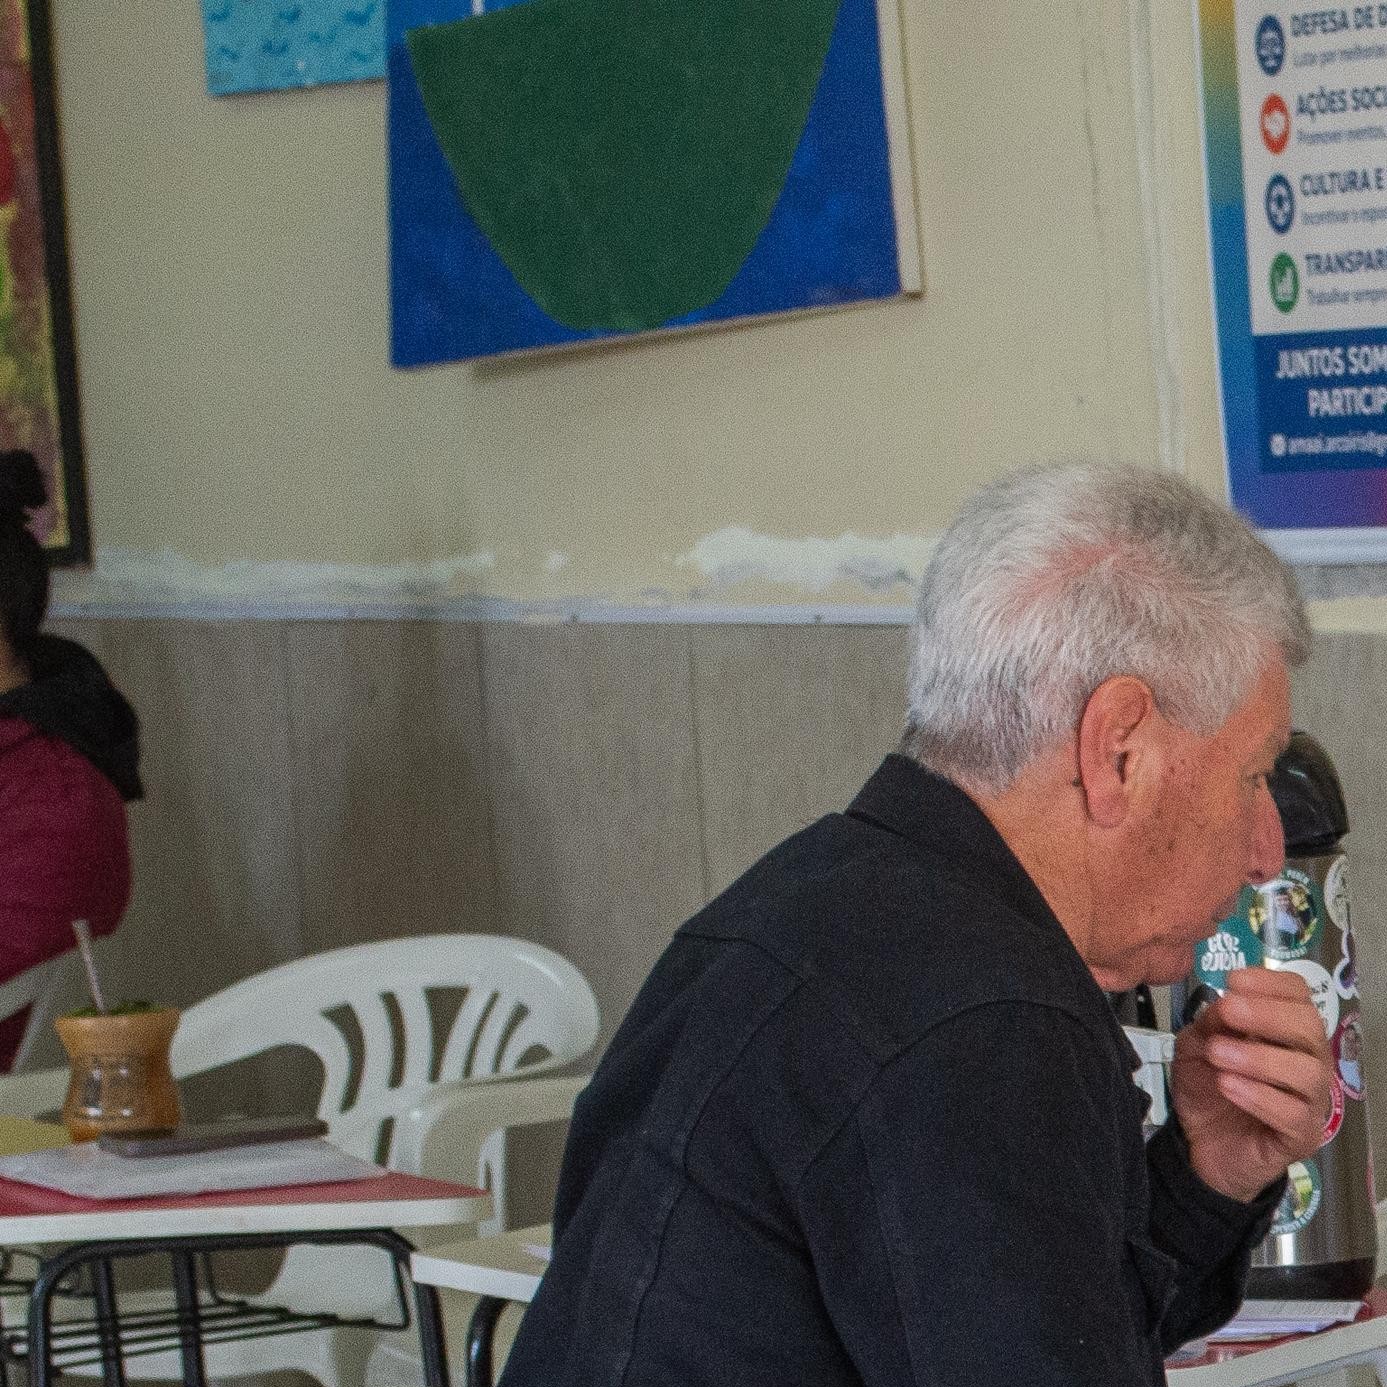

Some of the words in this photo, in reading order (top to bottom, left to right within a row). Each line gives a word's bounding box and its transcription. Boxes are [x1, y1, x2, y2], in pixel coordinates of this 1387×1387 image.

[1291, 10, 1349, 37] DEFESA
[1354, 5, 1375, 29] DE
[1296, 85, 1347, 122] AÇÕES
[1301, 168, 1370, 197] CULTURA
[1375, 167, 1386, 190] E
[1276, 347, 1345, 379] JUNTOS
